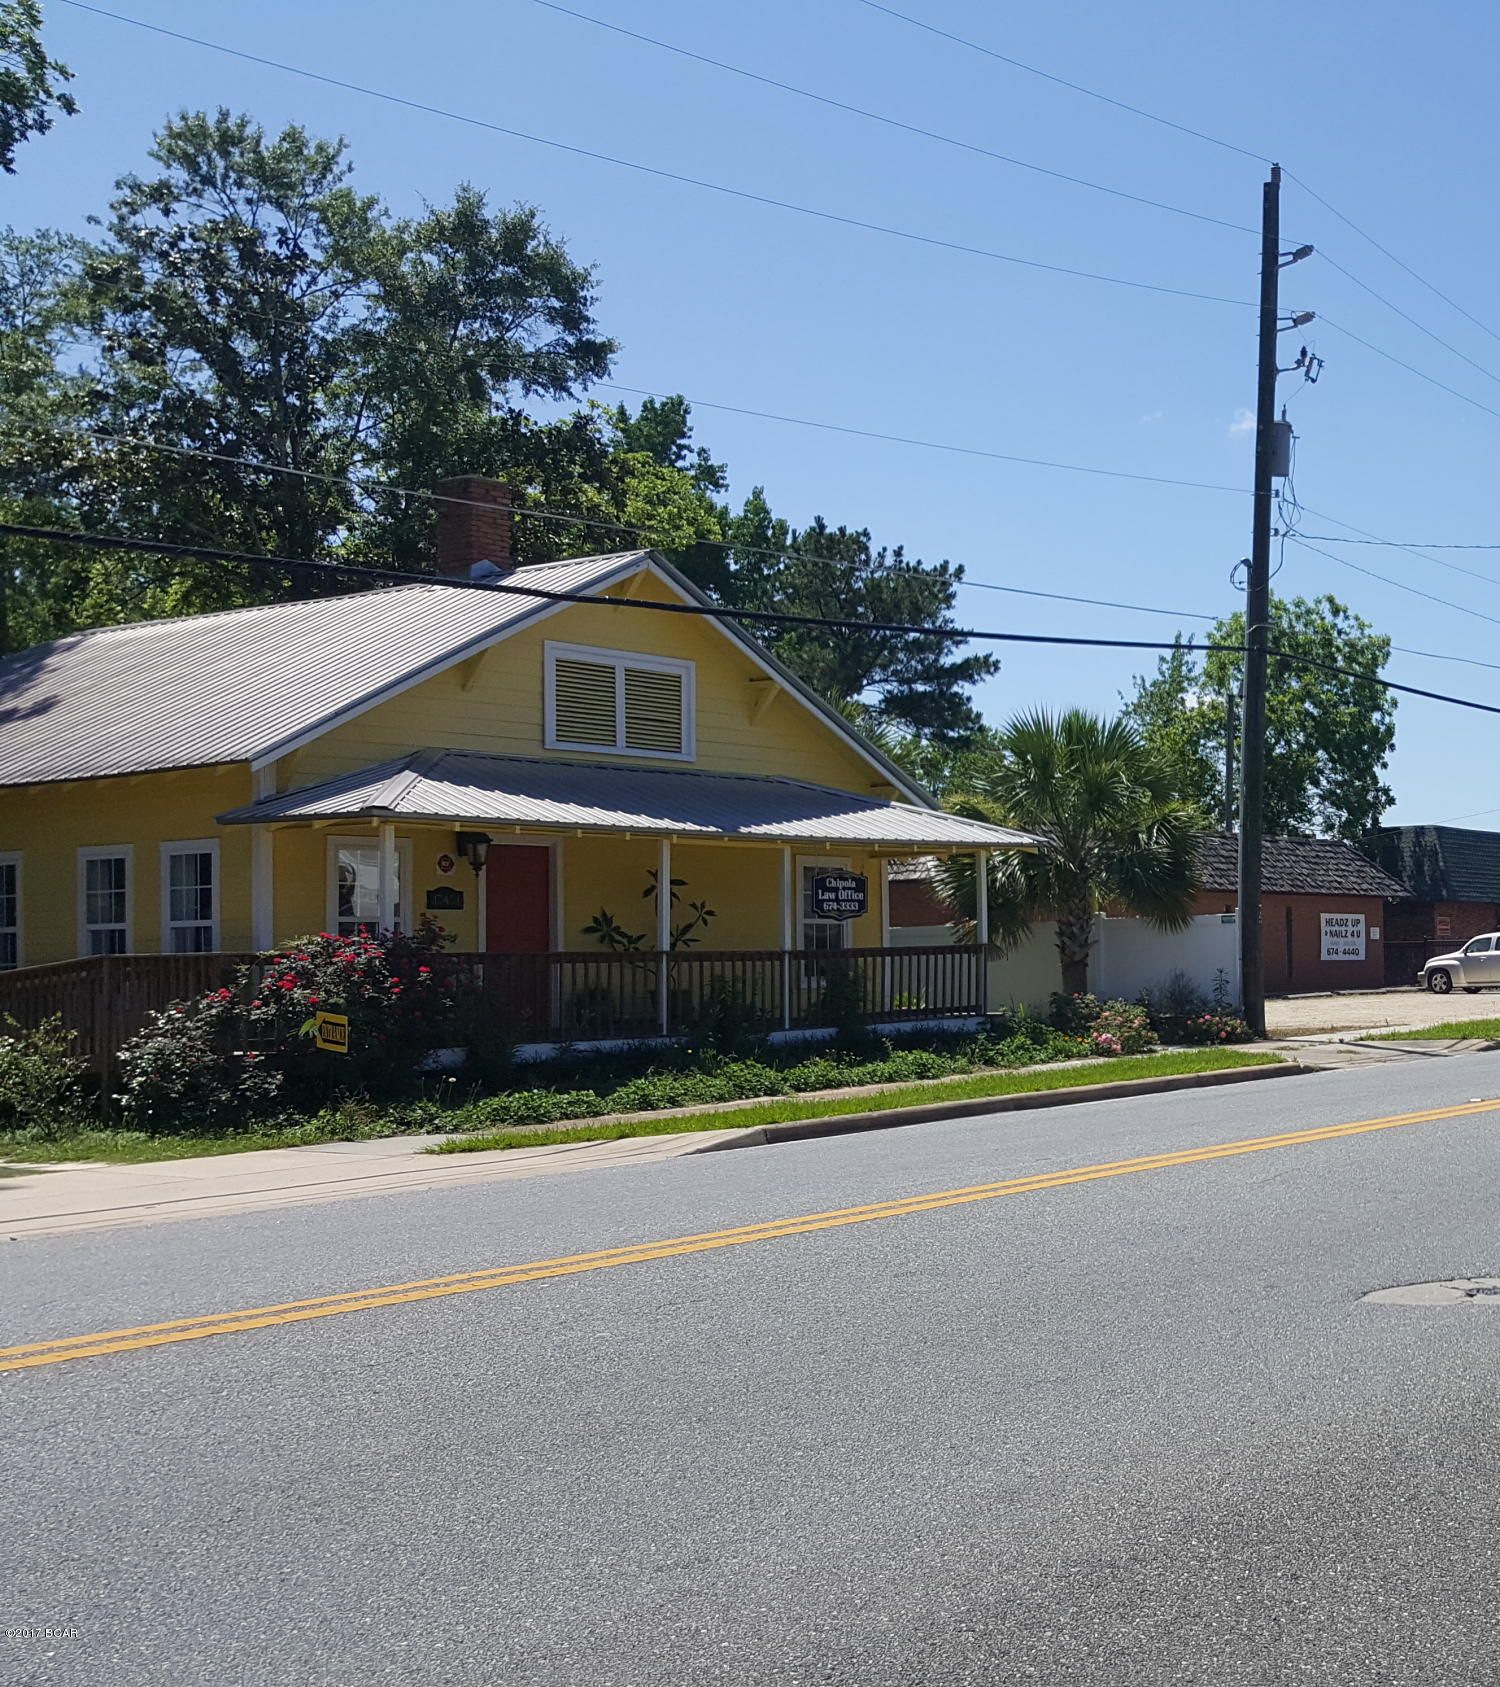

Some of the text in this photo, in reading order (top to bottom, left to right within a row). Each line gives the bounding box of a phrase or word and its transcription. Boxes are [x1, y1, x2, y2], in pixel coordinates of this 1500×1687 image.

[826, 878, 856, 889] Chipola
[818, 890, 864, 900] Law Office
[823, 901, 859, 910] 674-3333
[1325, 918, 1361, 927] HEADZ UP
[1329, 930, 1349, 938] NAILZ
[1350, 930, 1355, 938] 4
[1356, 930, 1361, 938] U
[1326, 948, 1360, 956] 674-4440
[321, 1022, 346, 1043] ENTRANCE
